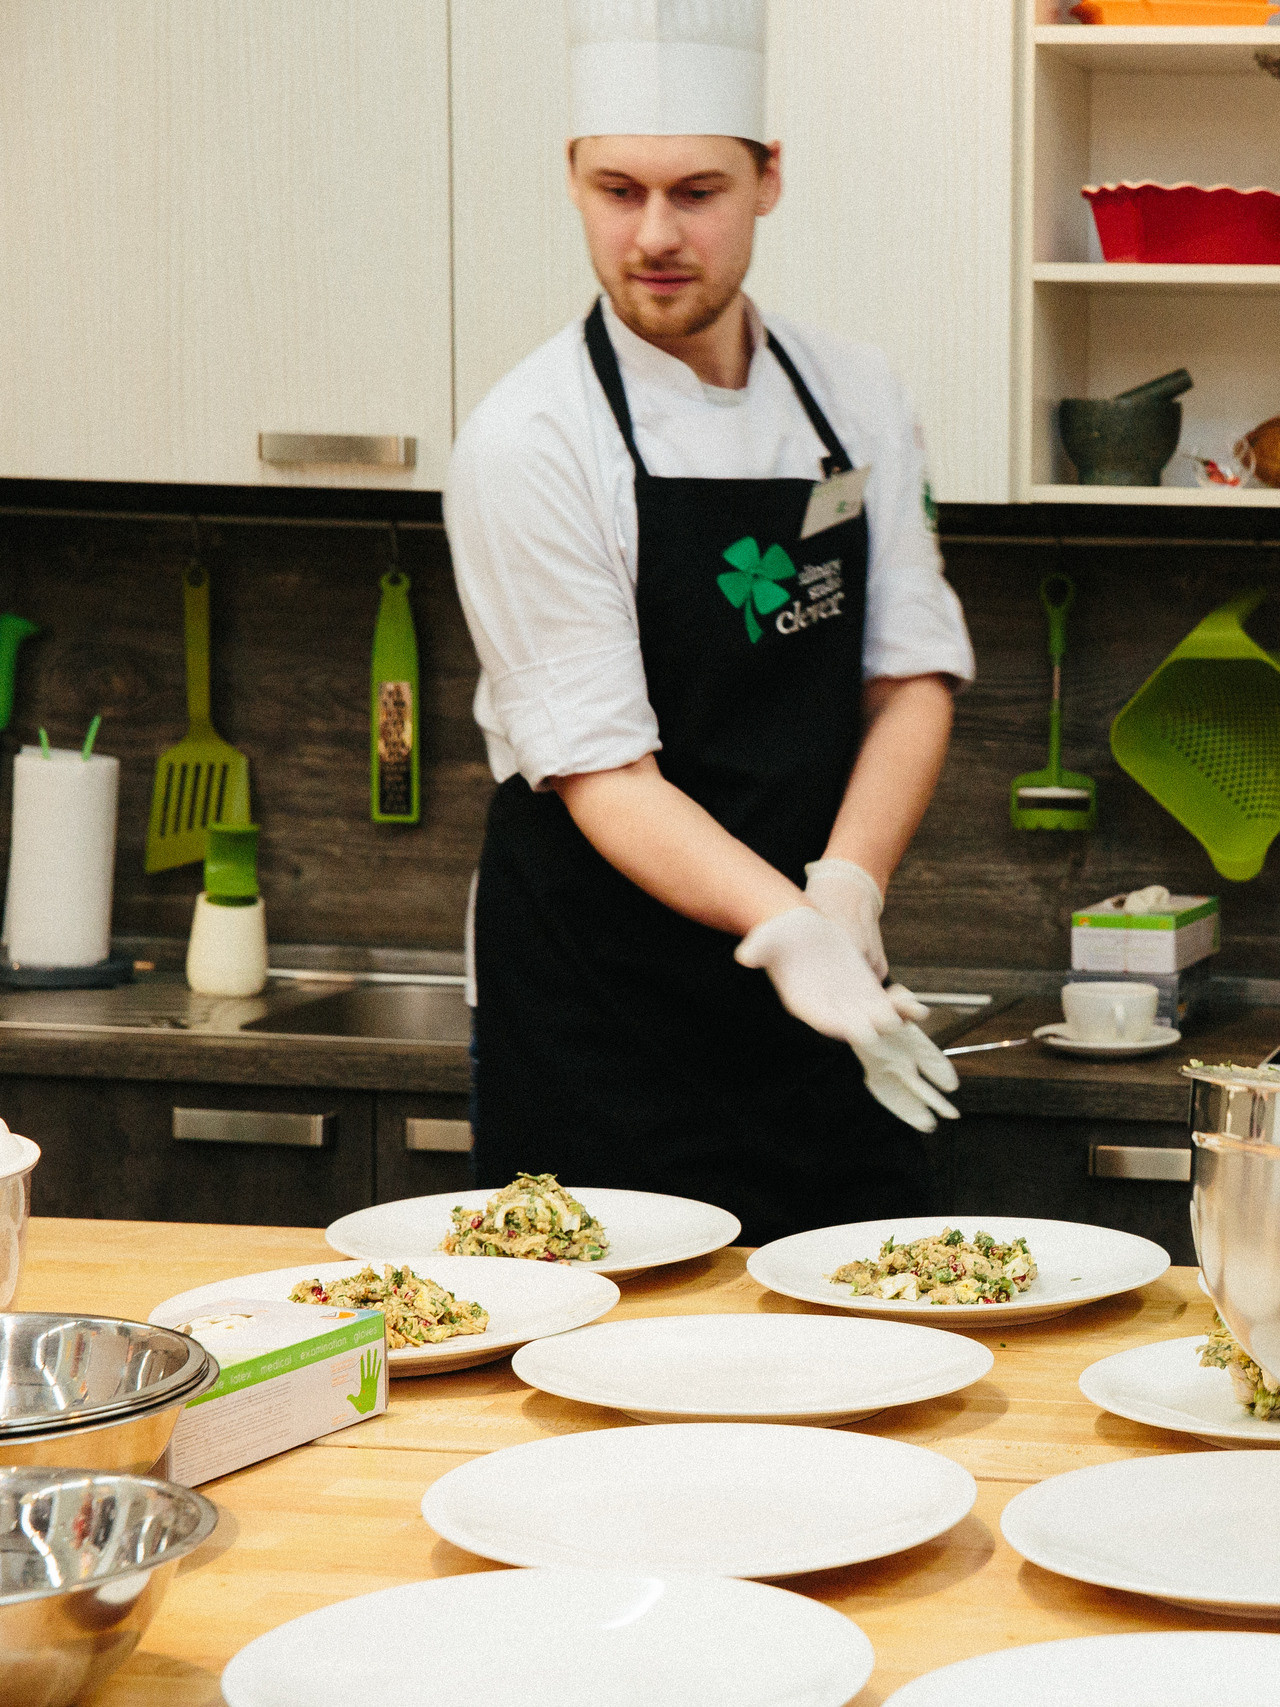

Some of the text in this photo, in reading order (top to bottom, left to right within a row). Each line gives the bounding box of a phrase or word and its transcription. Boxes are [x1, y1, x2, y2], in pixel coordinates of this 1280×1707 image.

[260, 1354, 293, 1375] medical
[300, 1336, 348, 1361] examination
[353, 1325, 378, 1345] gloves
